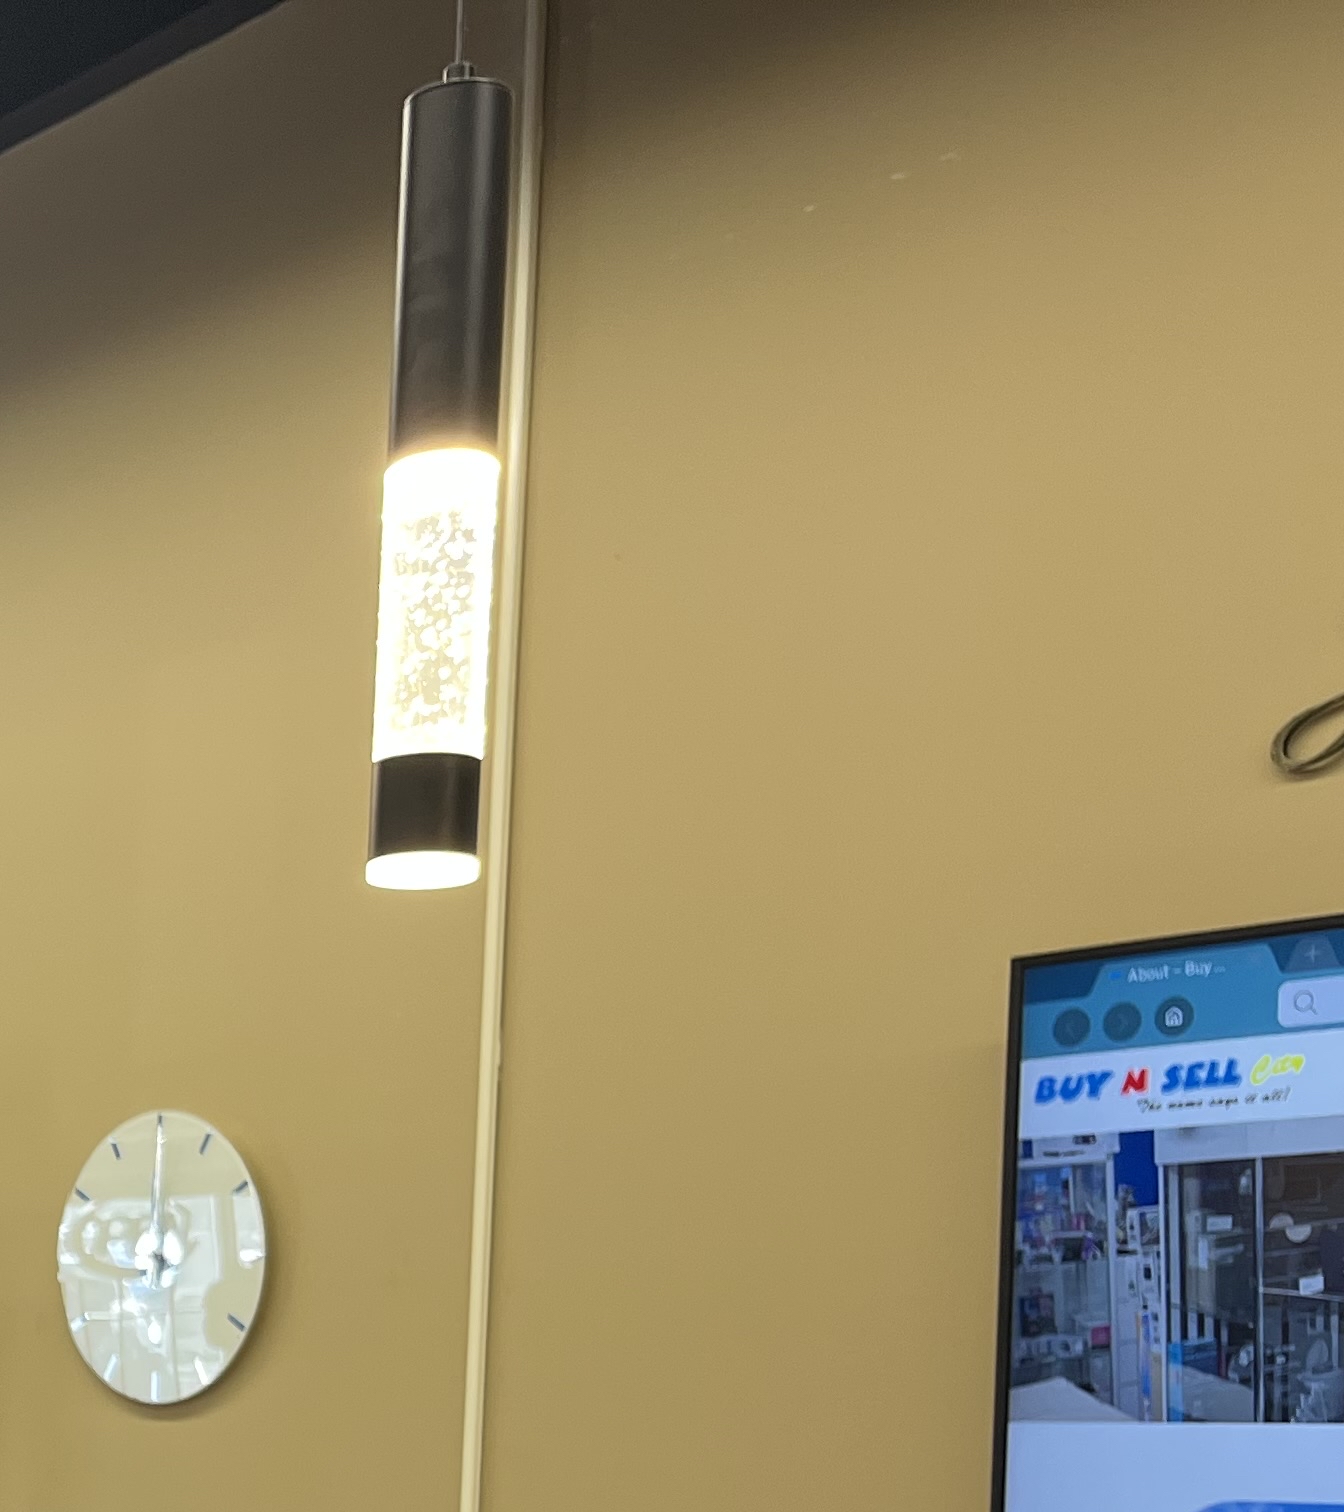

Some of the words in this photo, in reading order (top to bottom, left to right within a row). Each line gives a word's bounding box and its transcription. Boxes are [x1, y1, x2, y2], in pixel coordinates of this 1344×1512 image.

[1035, 1070, 1113, 1104] BUY
[1121, 1067, 1150, 1096] N
[1162, 1057, 1242, 1095] SELL
